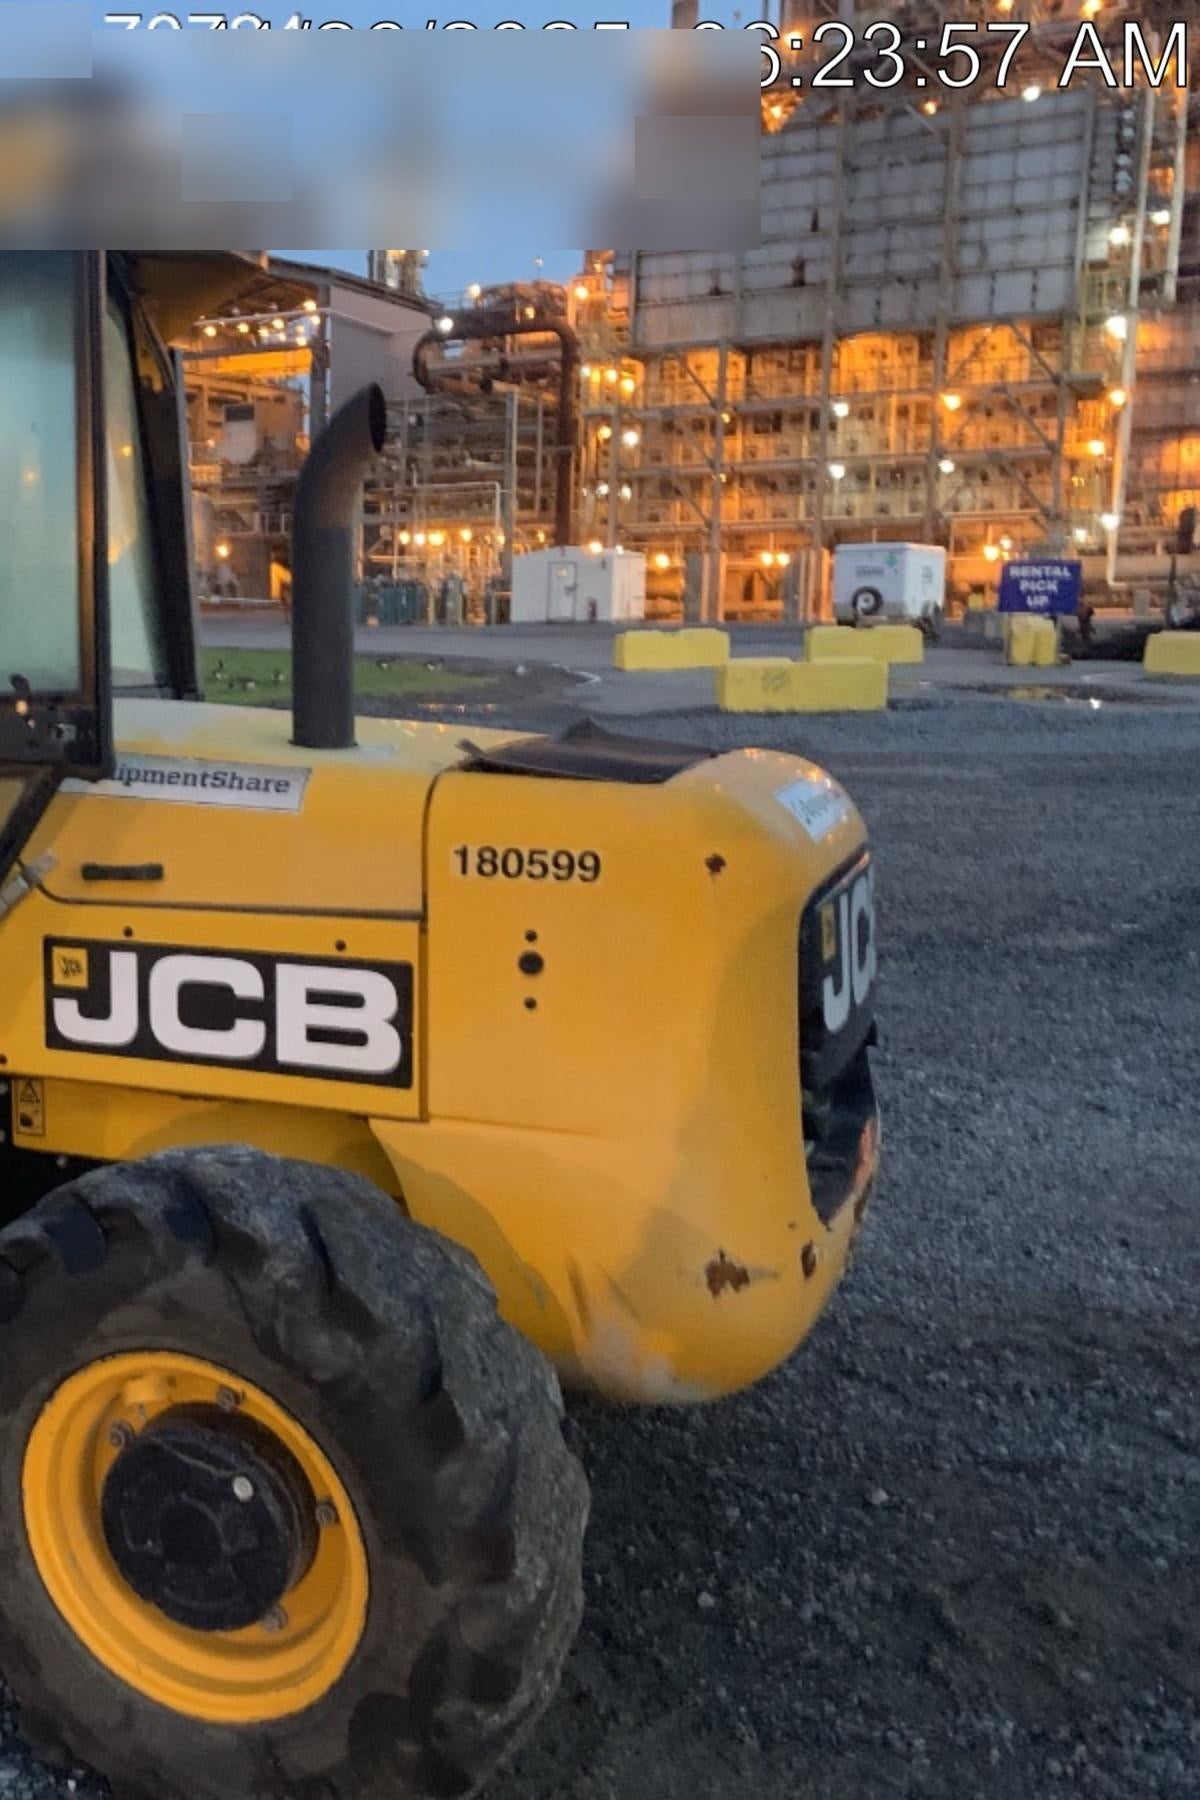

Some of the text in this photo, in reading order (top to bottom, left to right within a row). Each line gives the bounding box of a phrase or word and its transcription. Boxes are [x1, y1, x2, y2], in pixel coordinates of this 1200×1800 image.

[1008, 565, 1071, 578] RENTAL
[1019, 579, 1059, 592] PICK
[1026, 595, 1049, 607] UP
[109, 762, 291, 794] ipmentShare
[452, 843, 602, 883] 180599
[52, 951, 402, 1075] JCB
